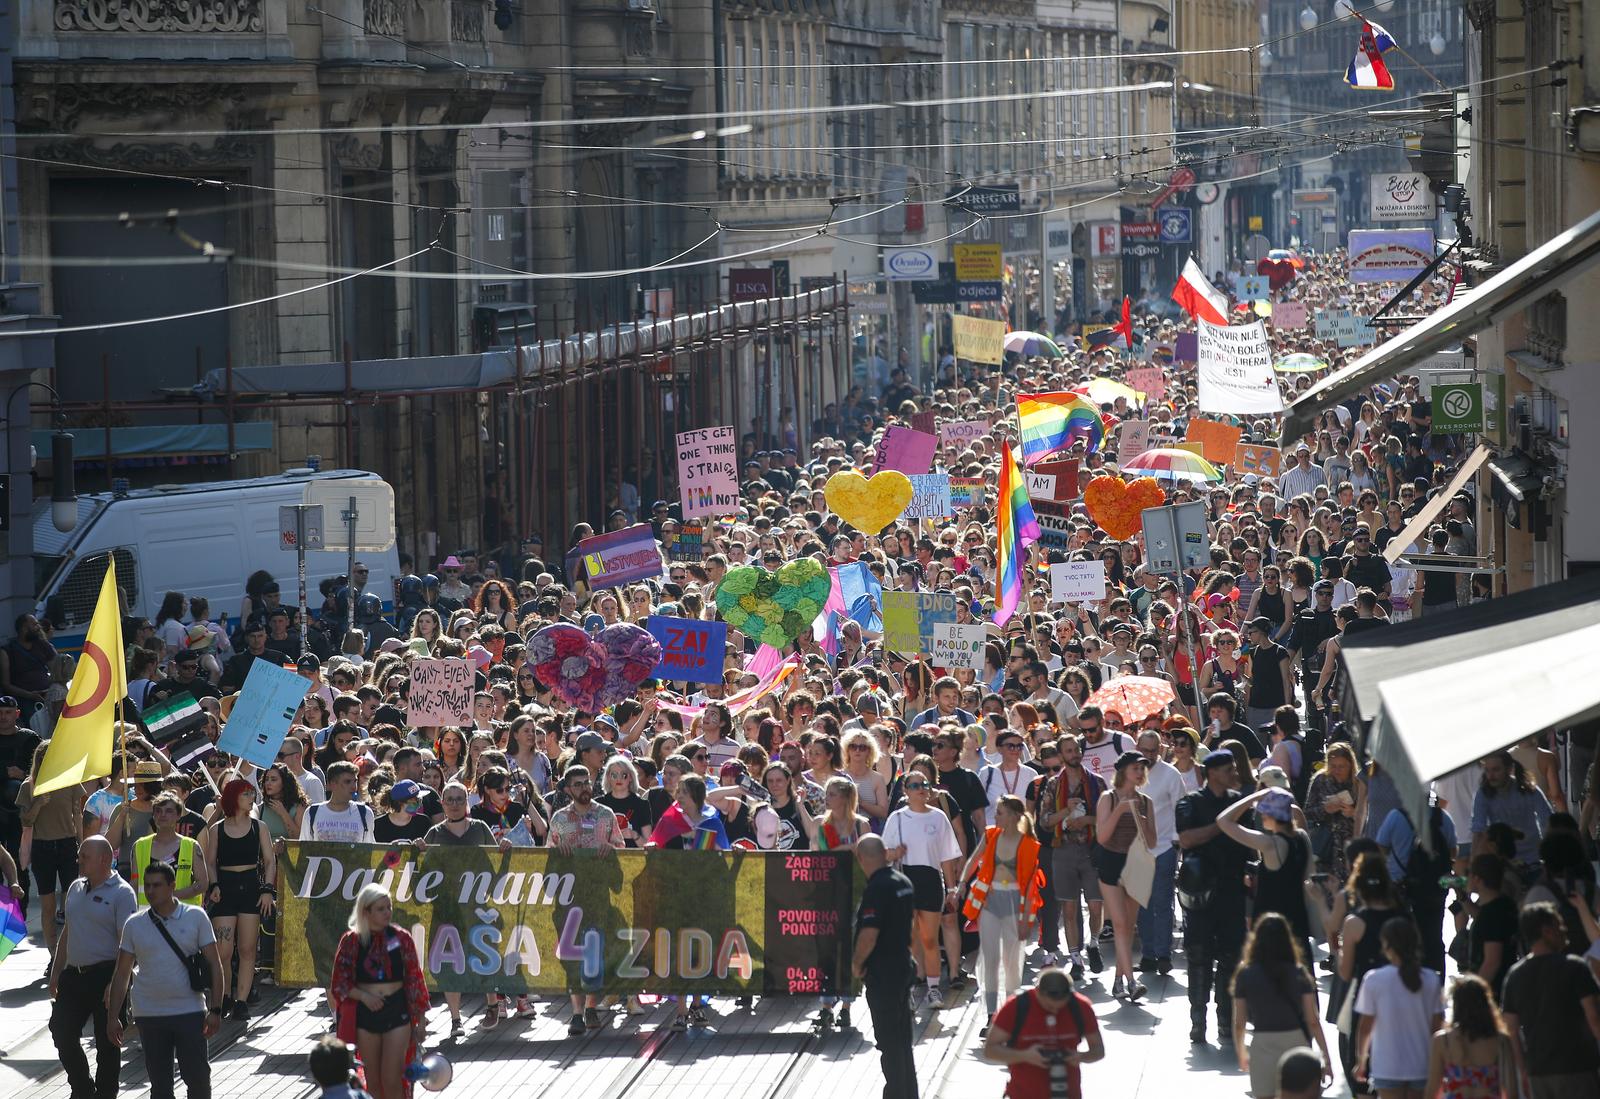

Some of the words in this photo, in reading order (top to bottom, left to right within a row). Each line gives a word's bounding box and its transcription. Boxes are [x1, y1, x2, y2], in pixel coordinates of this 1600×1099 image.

[956, 193, 1017, 204] STRUGAR
[1122, 224, 1152, 234] Triumph
[895, 257, 926, 267] Oculus
[1365, 260, 1418, 268] CENTAR
[735, 283, 767, 294] LISCA
[1330, 320, 1339, 328] SU
[1220, 330, 1239, 342] KVIR
[1241, 329, 1259, 341] NIJE
[1200, 349, 1213, 359] BITI
[1237, 341, 1268, 355] BOLEST
[677, 429, 709, 446] LET'S
[712, 427, 734, 438] GET
[947, 424, 974, 438] HOD
[680, 449, 701, 461] ONE
[706, 443, 735, 455] THING
[687, 461, 737, 483] STRAIGHT
[1032, 477, 1050, 490] AM
[688, 485, 713, 510] I'M
[715, 494, 738, 506] NOT
[1037, 515, 1068, 530] ATKA
[949, 626, 964, 639] BE
[936, 639, 969, 651] PROUD
[971, 641, 985, 653] OF
[934, 650, 955, 660] WHO
[956, 651, 973, 660] YOU
[413, 665, 440, 684] CAN'T
[443, 663, 471, 683] EVEN
[434, 684, 474, 717] STRAIGHT
[785, 856, 836, 868] ZAGREB
[791, 869, 830, 882] PRIDE
[458, 870, 575, 905] nam
[778, 910, 839, 923] POVORKA
[782, 923, 835, 936] PONOSA
[411, 908, 540, 977] AŠA
[555, 906, 602, 979] 4
[615, 927, 753, 980] ZIDA
